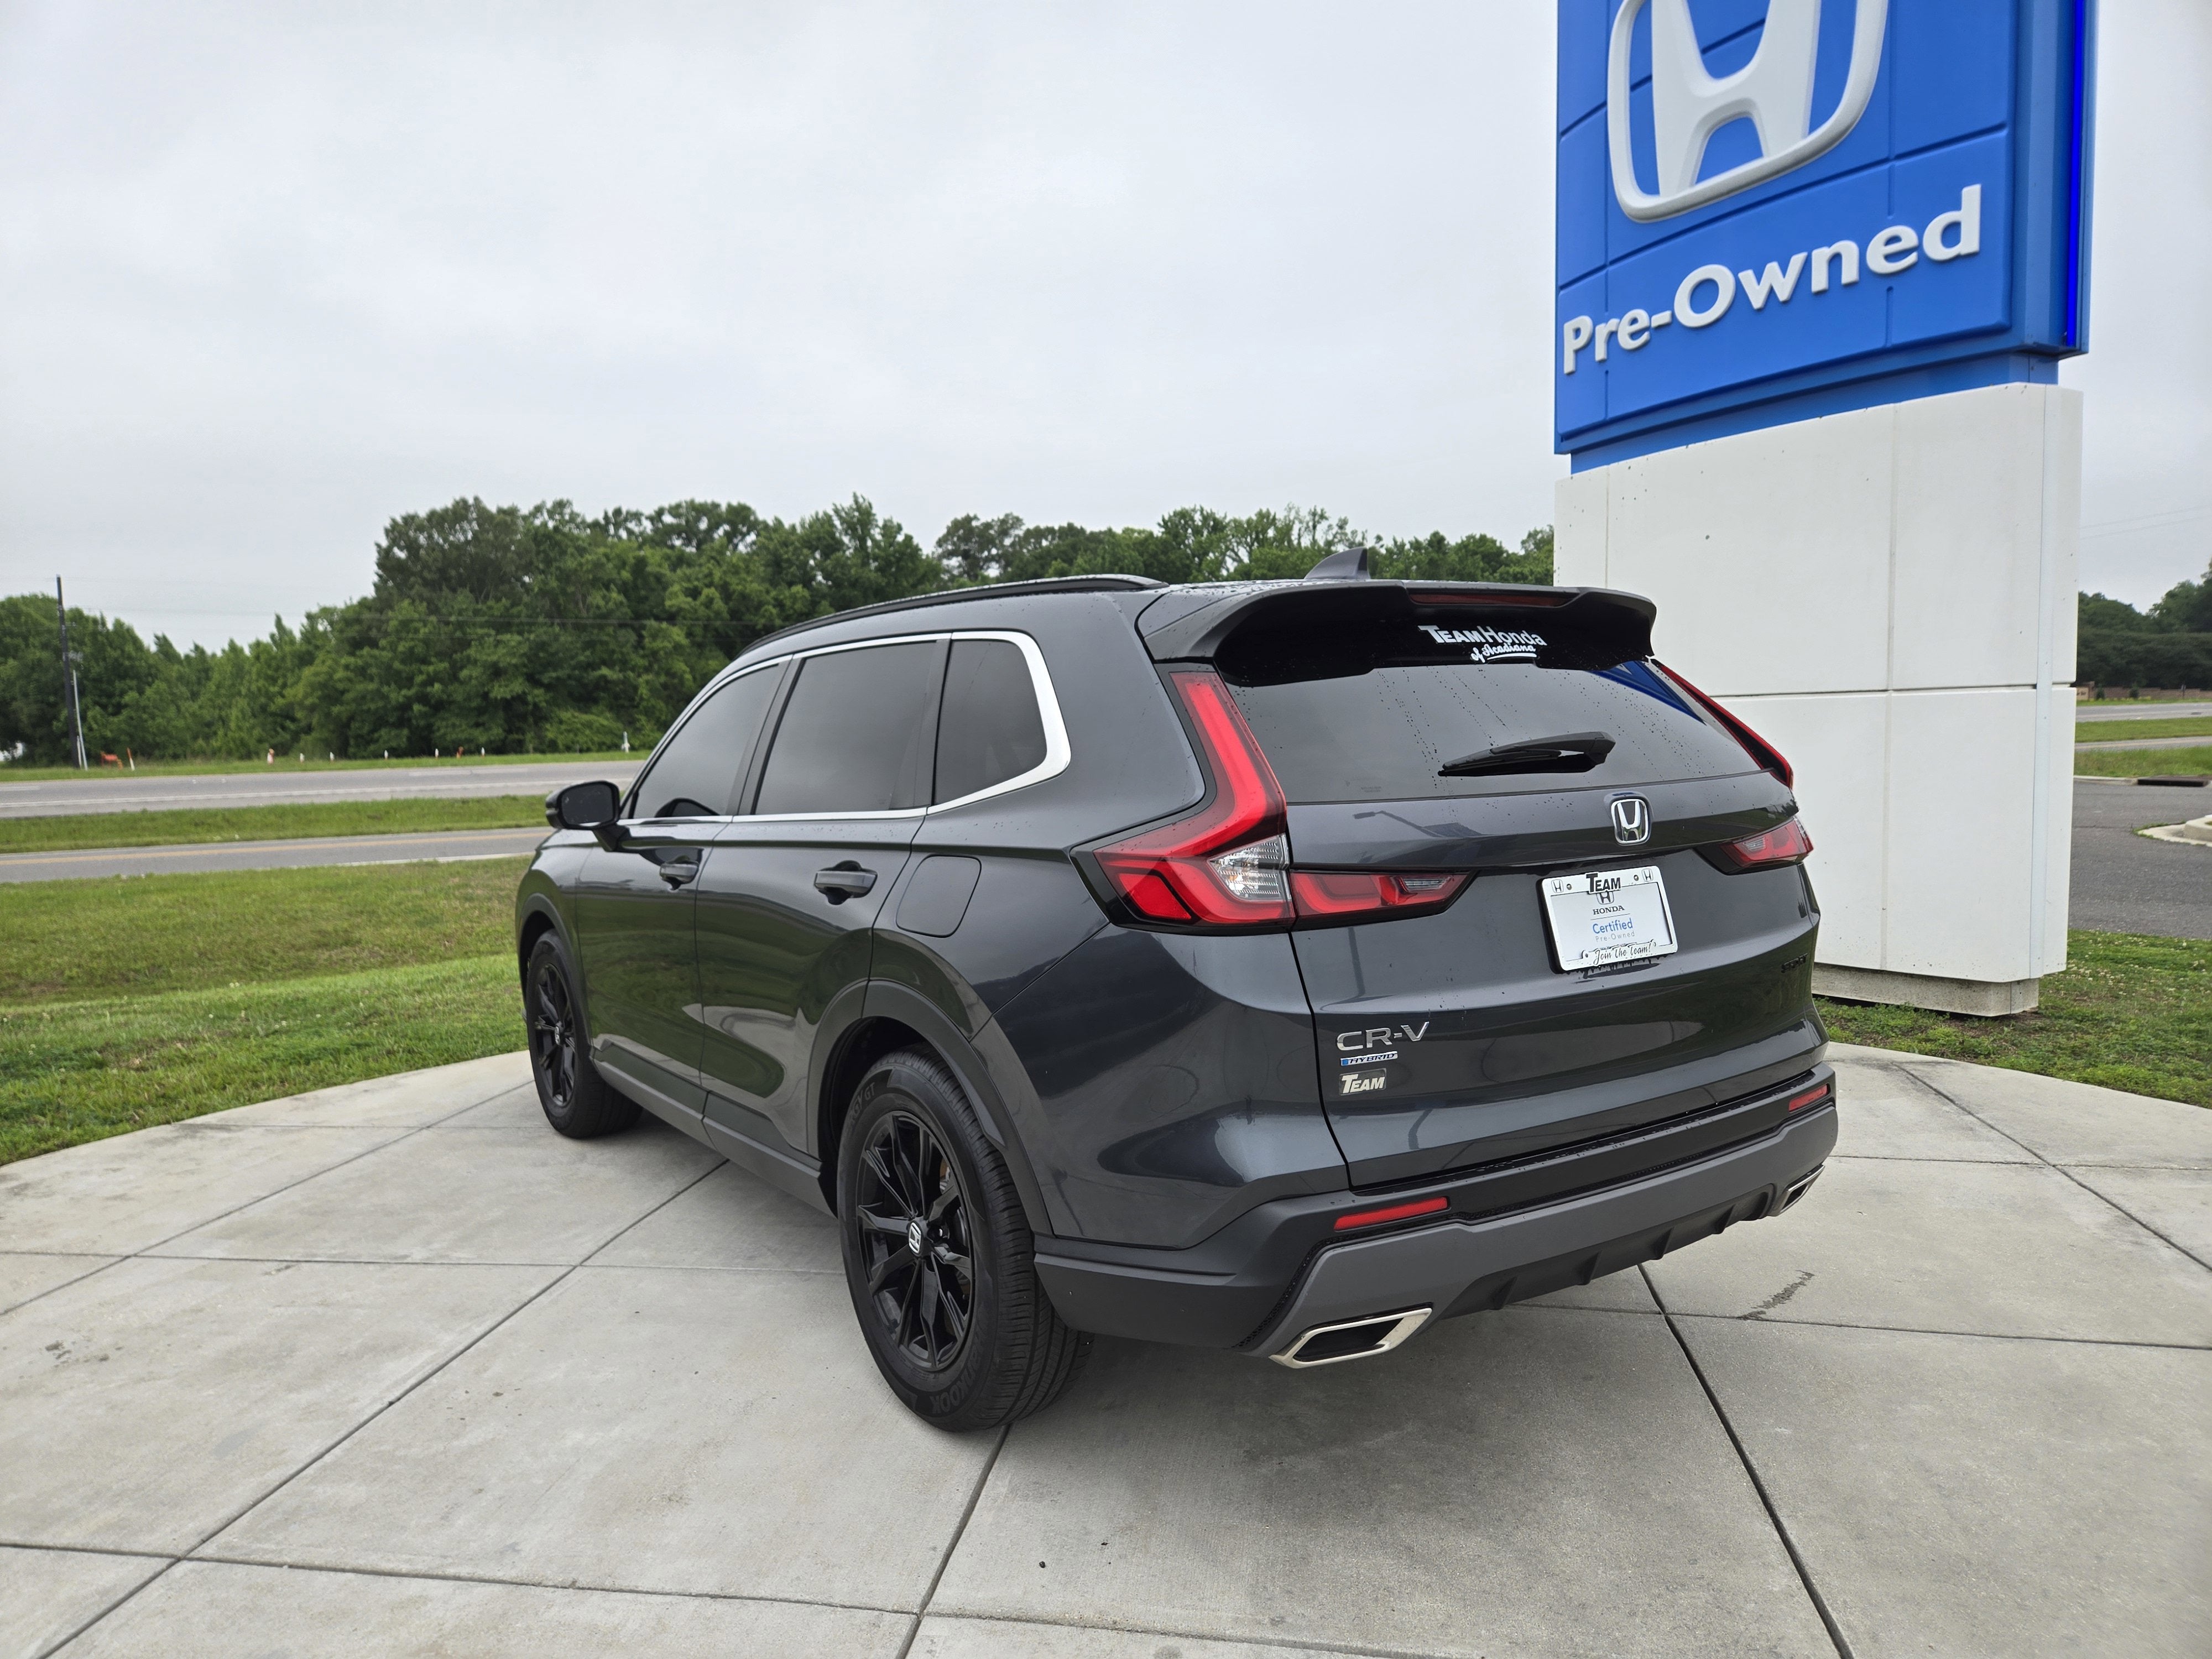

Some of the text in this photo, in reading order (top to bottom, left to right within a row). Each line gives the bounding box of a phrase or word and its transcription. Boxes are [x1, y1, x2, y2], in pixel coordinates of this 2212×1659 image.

[1563, 184, 1981, 374] Pre-Owned
[1418, 625, 1547, 646] TEAM Honda
[1470, 643, 1536, 662] of Acadiana
[1586, 873, 1621, 893] TEAM
[1593, 905, 1625, 915] HONDA
[1593, 918, 1633, 934] Certified
[1595, 931, 1635, 942] Pre-Owned
[1593, 943, 1651, 966] Join The Team!
[1337, 1021, 1430, 1051] CR-V
[1350, 1053, 1395, 1063] HYBRID
[1342, 1074, 1385, 1093] TEAM
